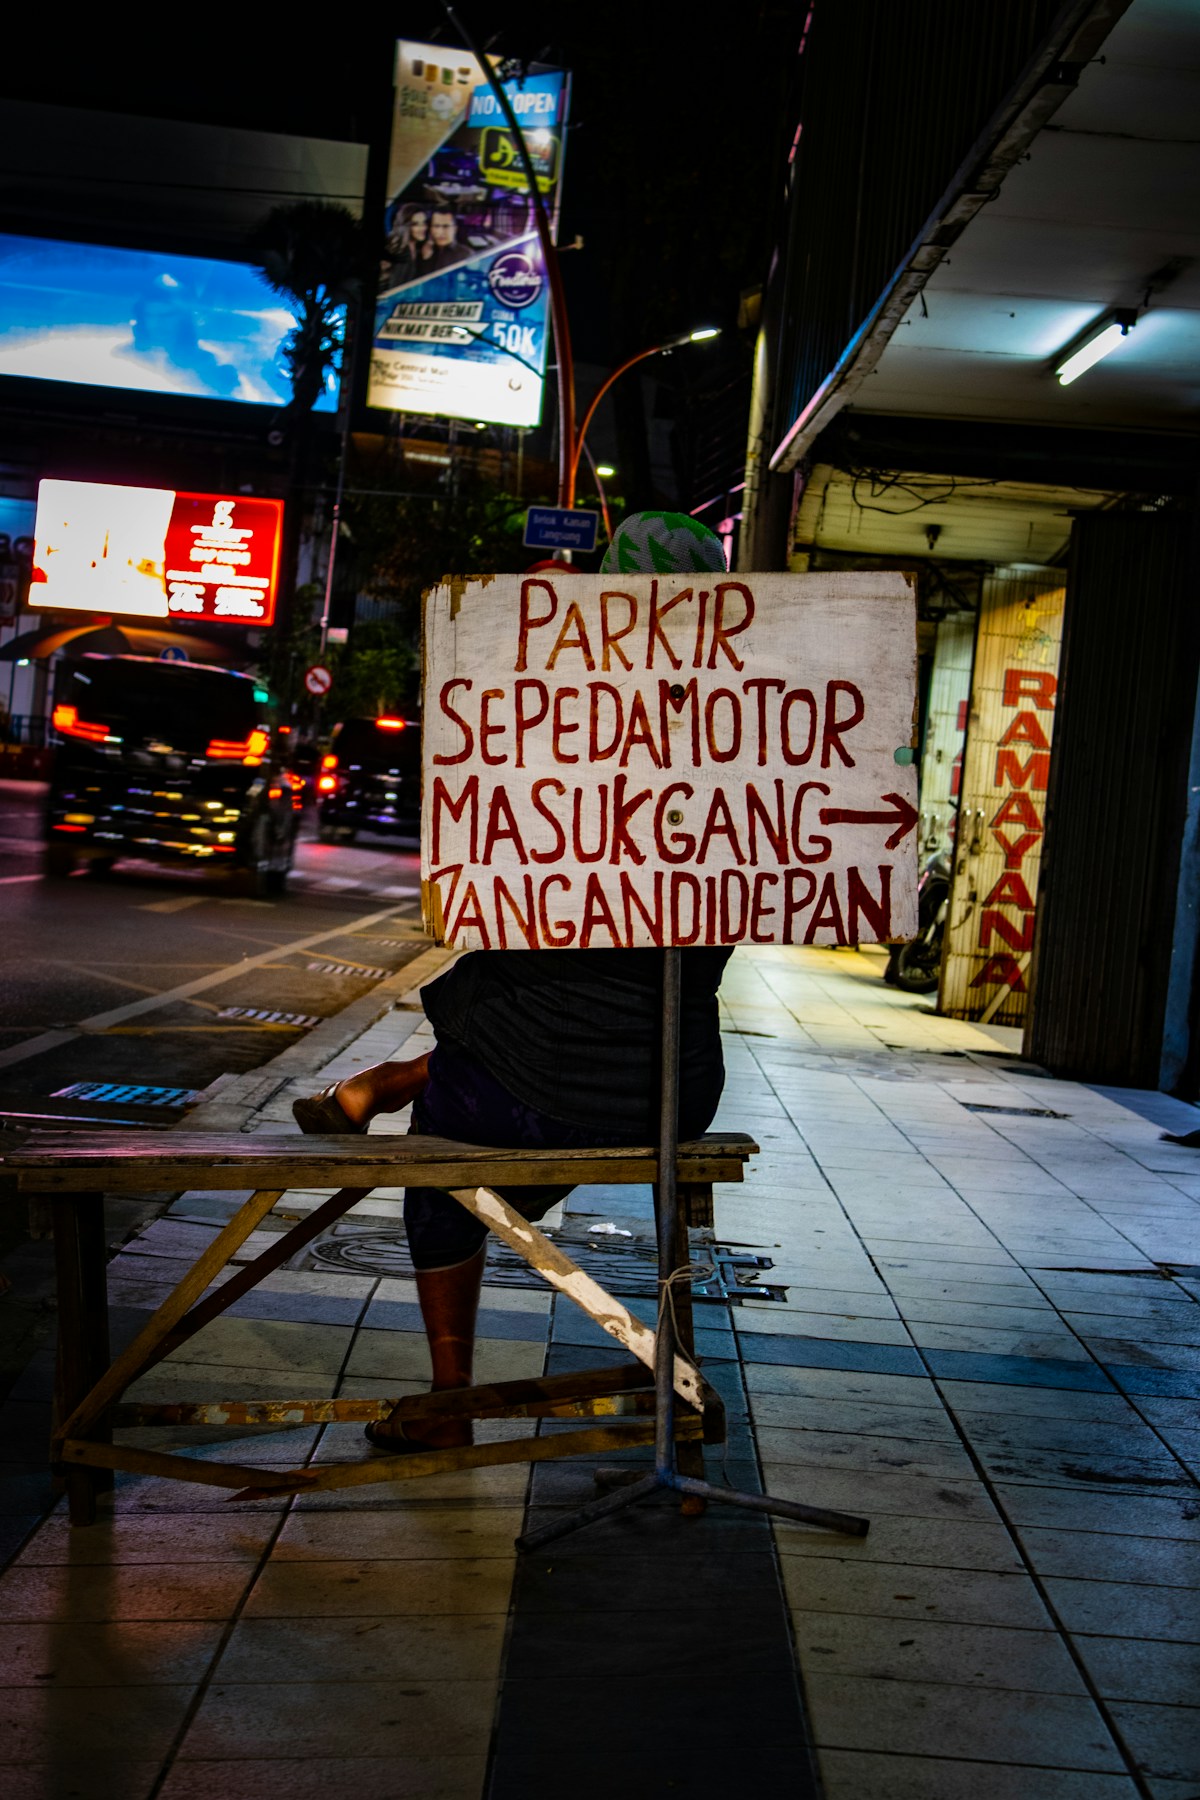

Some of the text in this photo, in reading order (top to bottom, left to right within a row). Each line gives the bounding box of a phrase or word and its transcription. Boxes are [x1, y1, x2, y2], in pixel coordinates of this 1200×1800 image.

[513, 93, 556, 114] OPEN
[399, 303, 479, 318] MAKAN HEMAT
[384, 322, 429, 337] NIKMAT
[493, 322, 536, 356] 50K
[514, 578, 755, 671] PARKIR
[969, 668, 1058, 993] RAMAYANA
